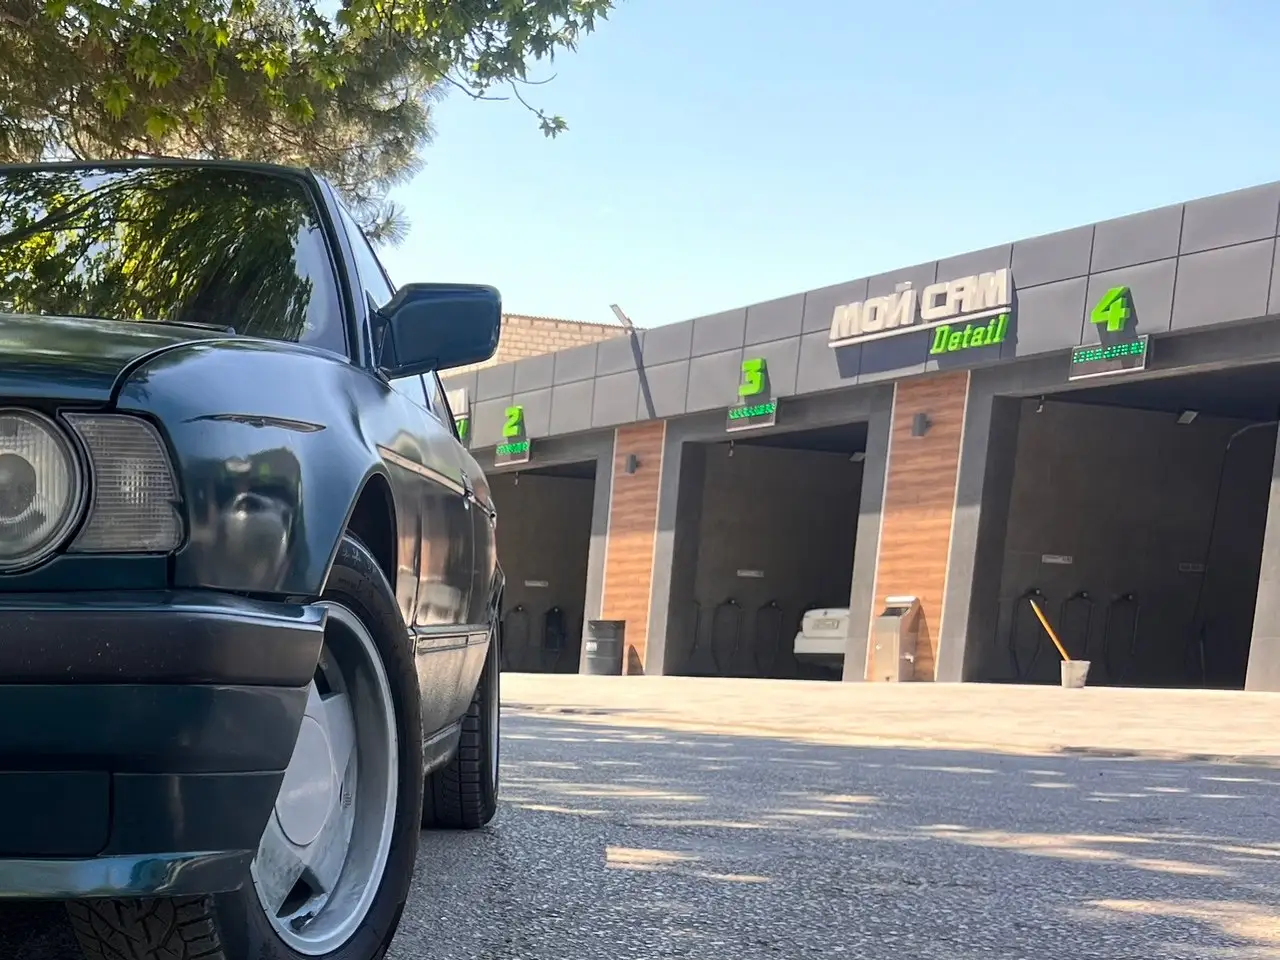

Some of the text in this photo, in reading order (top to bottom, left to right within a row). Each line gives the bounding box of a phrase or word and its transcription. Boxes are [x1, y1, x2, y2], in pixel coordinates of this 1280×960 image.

[830, 281, 917, 340] МОЙ
[1090, 286, 1130, 331] 4
[930, 314, 1009, 355] Detail
[738, 358, 765, 396] 3
[502, 405, 523, 437] 2
